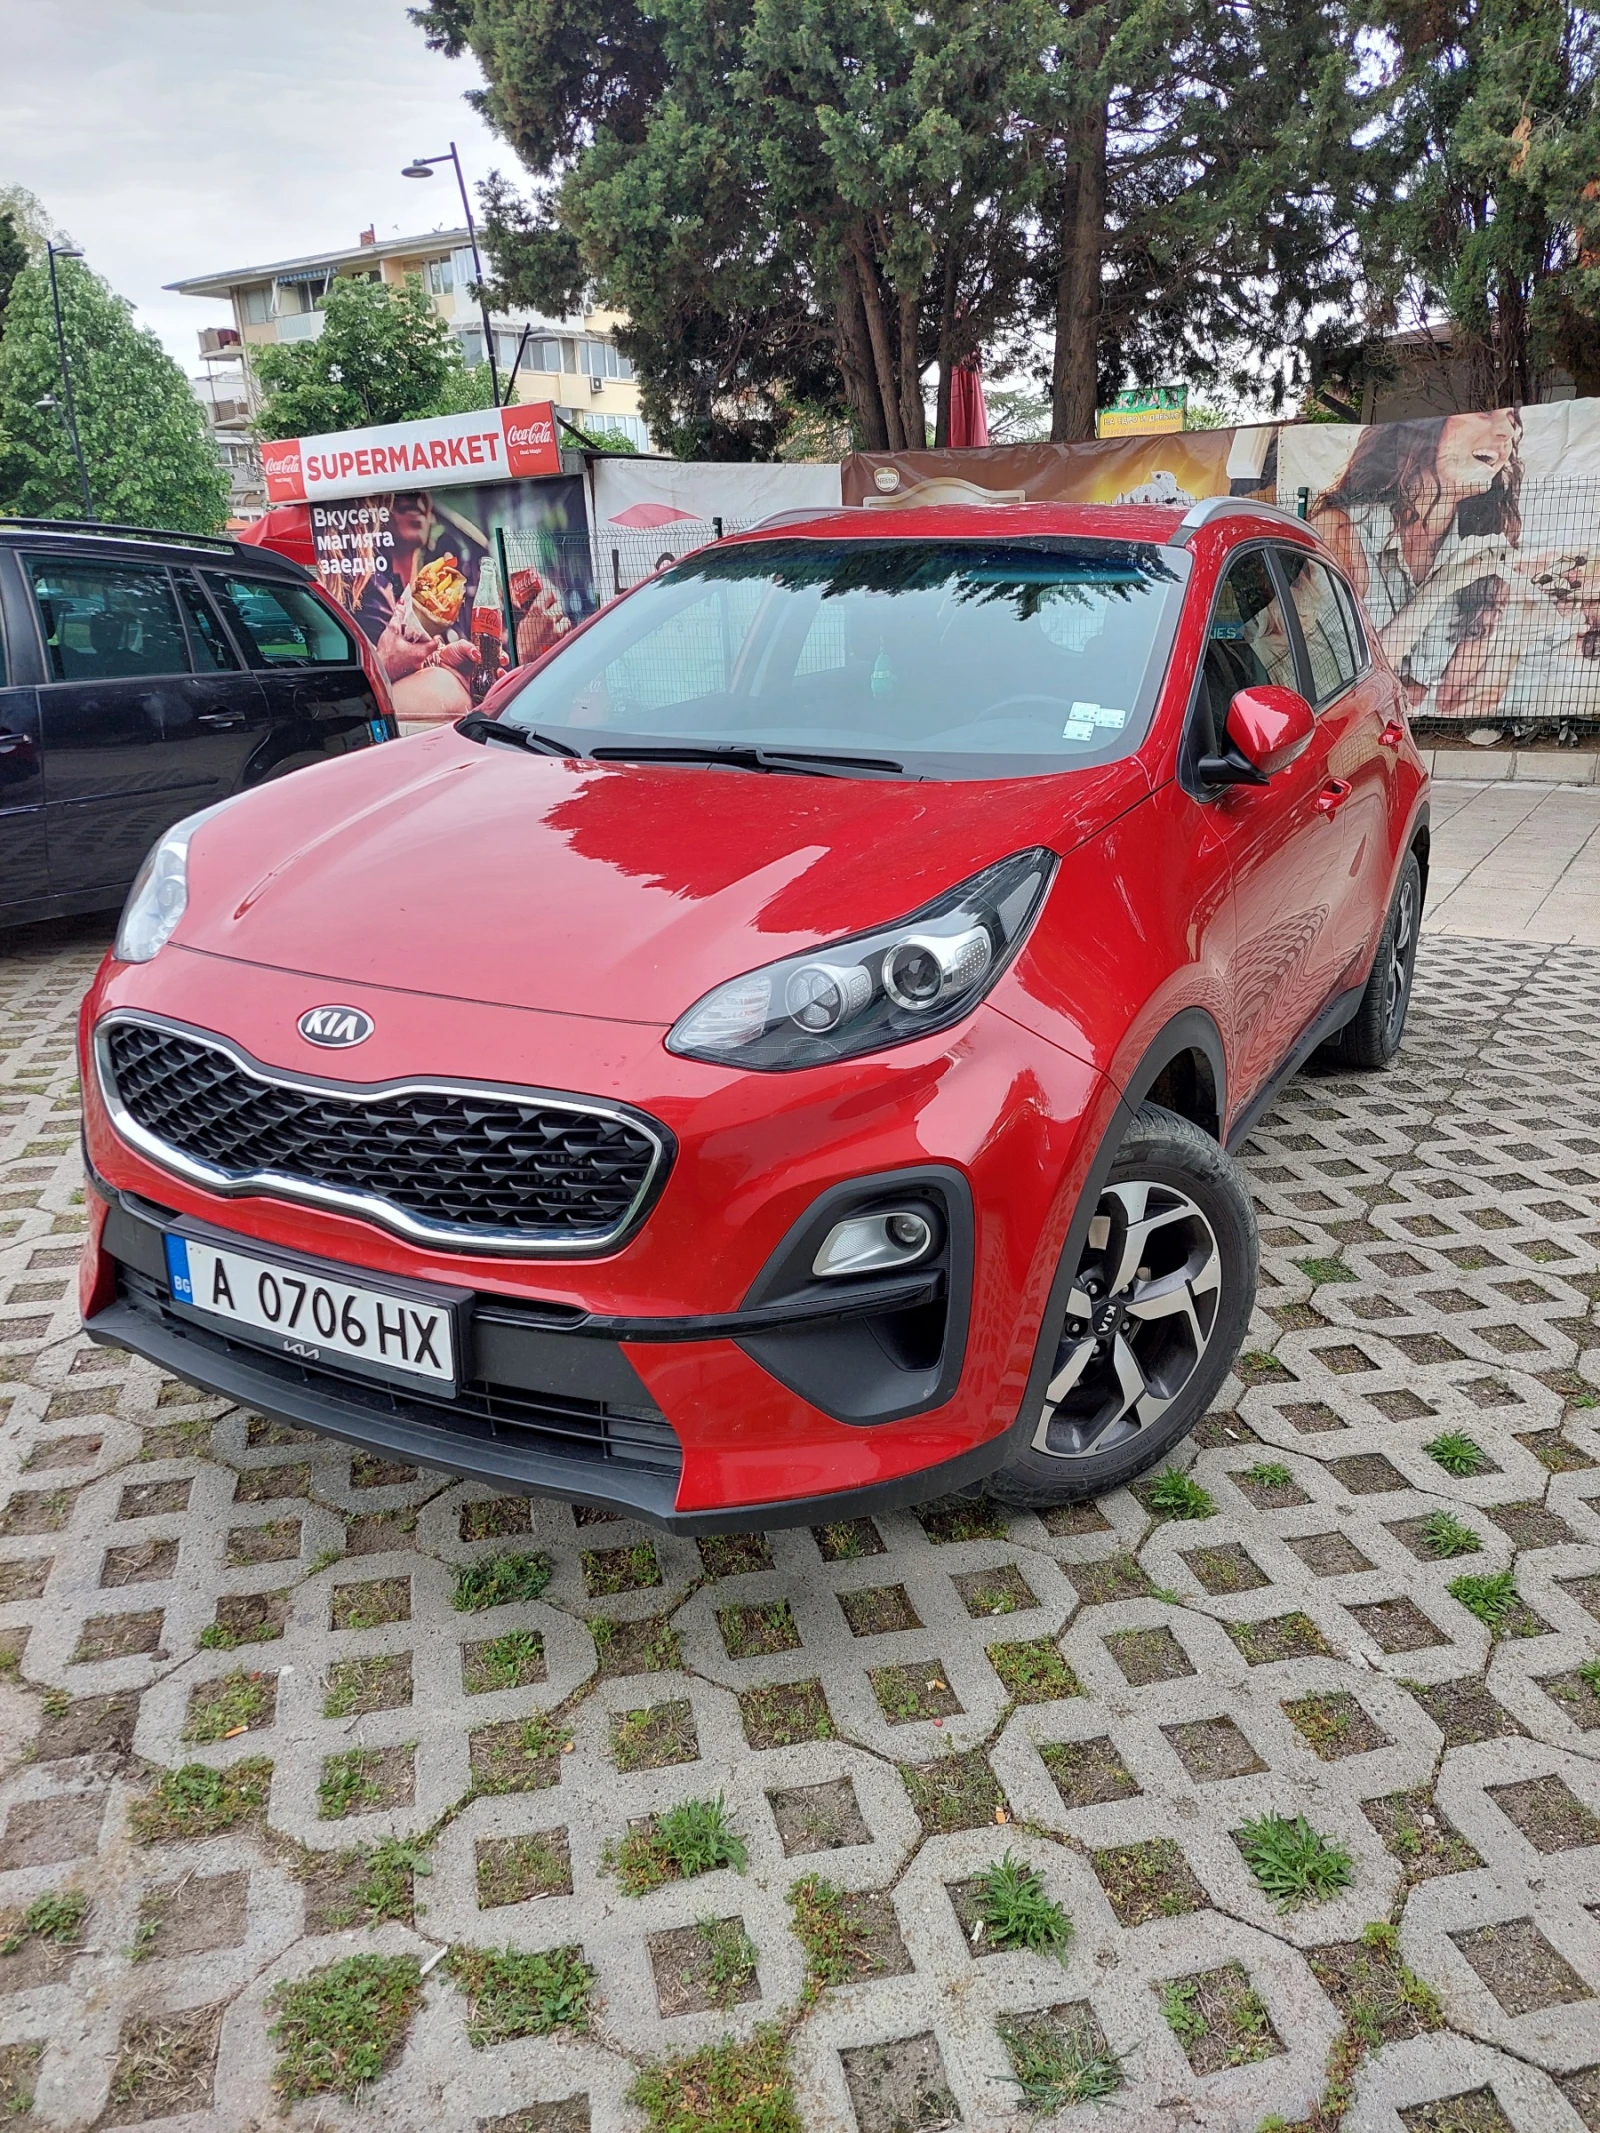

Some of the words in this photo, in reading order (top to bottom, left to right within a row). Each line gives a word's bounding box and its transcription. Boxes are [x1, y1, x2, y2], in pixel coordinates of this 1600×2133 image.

[306, 432, 500, 482] SUPERMARKET
[313, 506, 390, 530] Вкусете
[316, 531, 395, 551] магията
[320, 556, 388, 577] заедно
[304, 1010, 359, 1041] KIA
[173, 1274, 192, 1292] BG
[212, 1257, 236, 1311] A
[258, 1271, 367, 1347] 0706
[376, 1302, 443, 1370] HX
[1097, 1305, 1117, 1332] KIA
